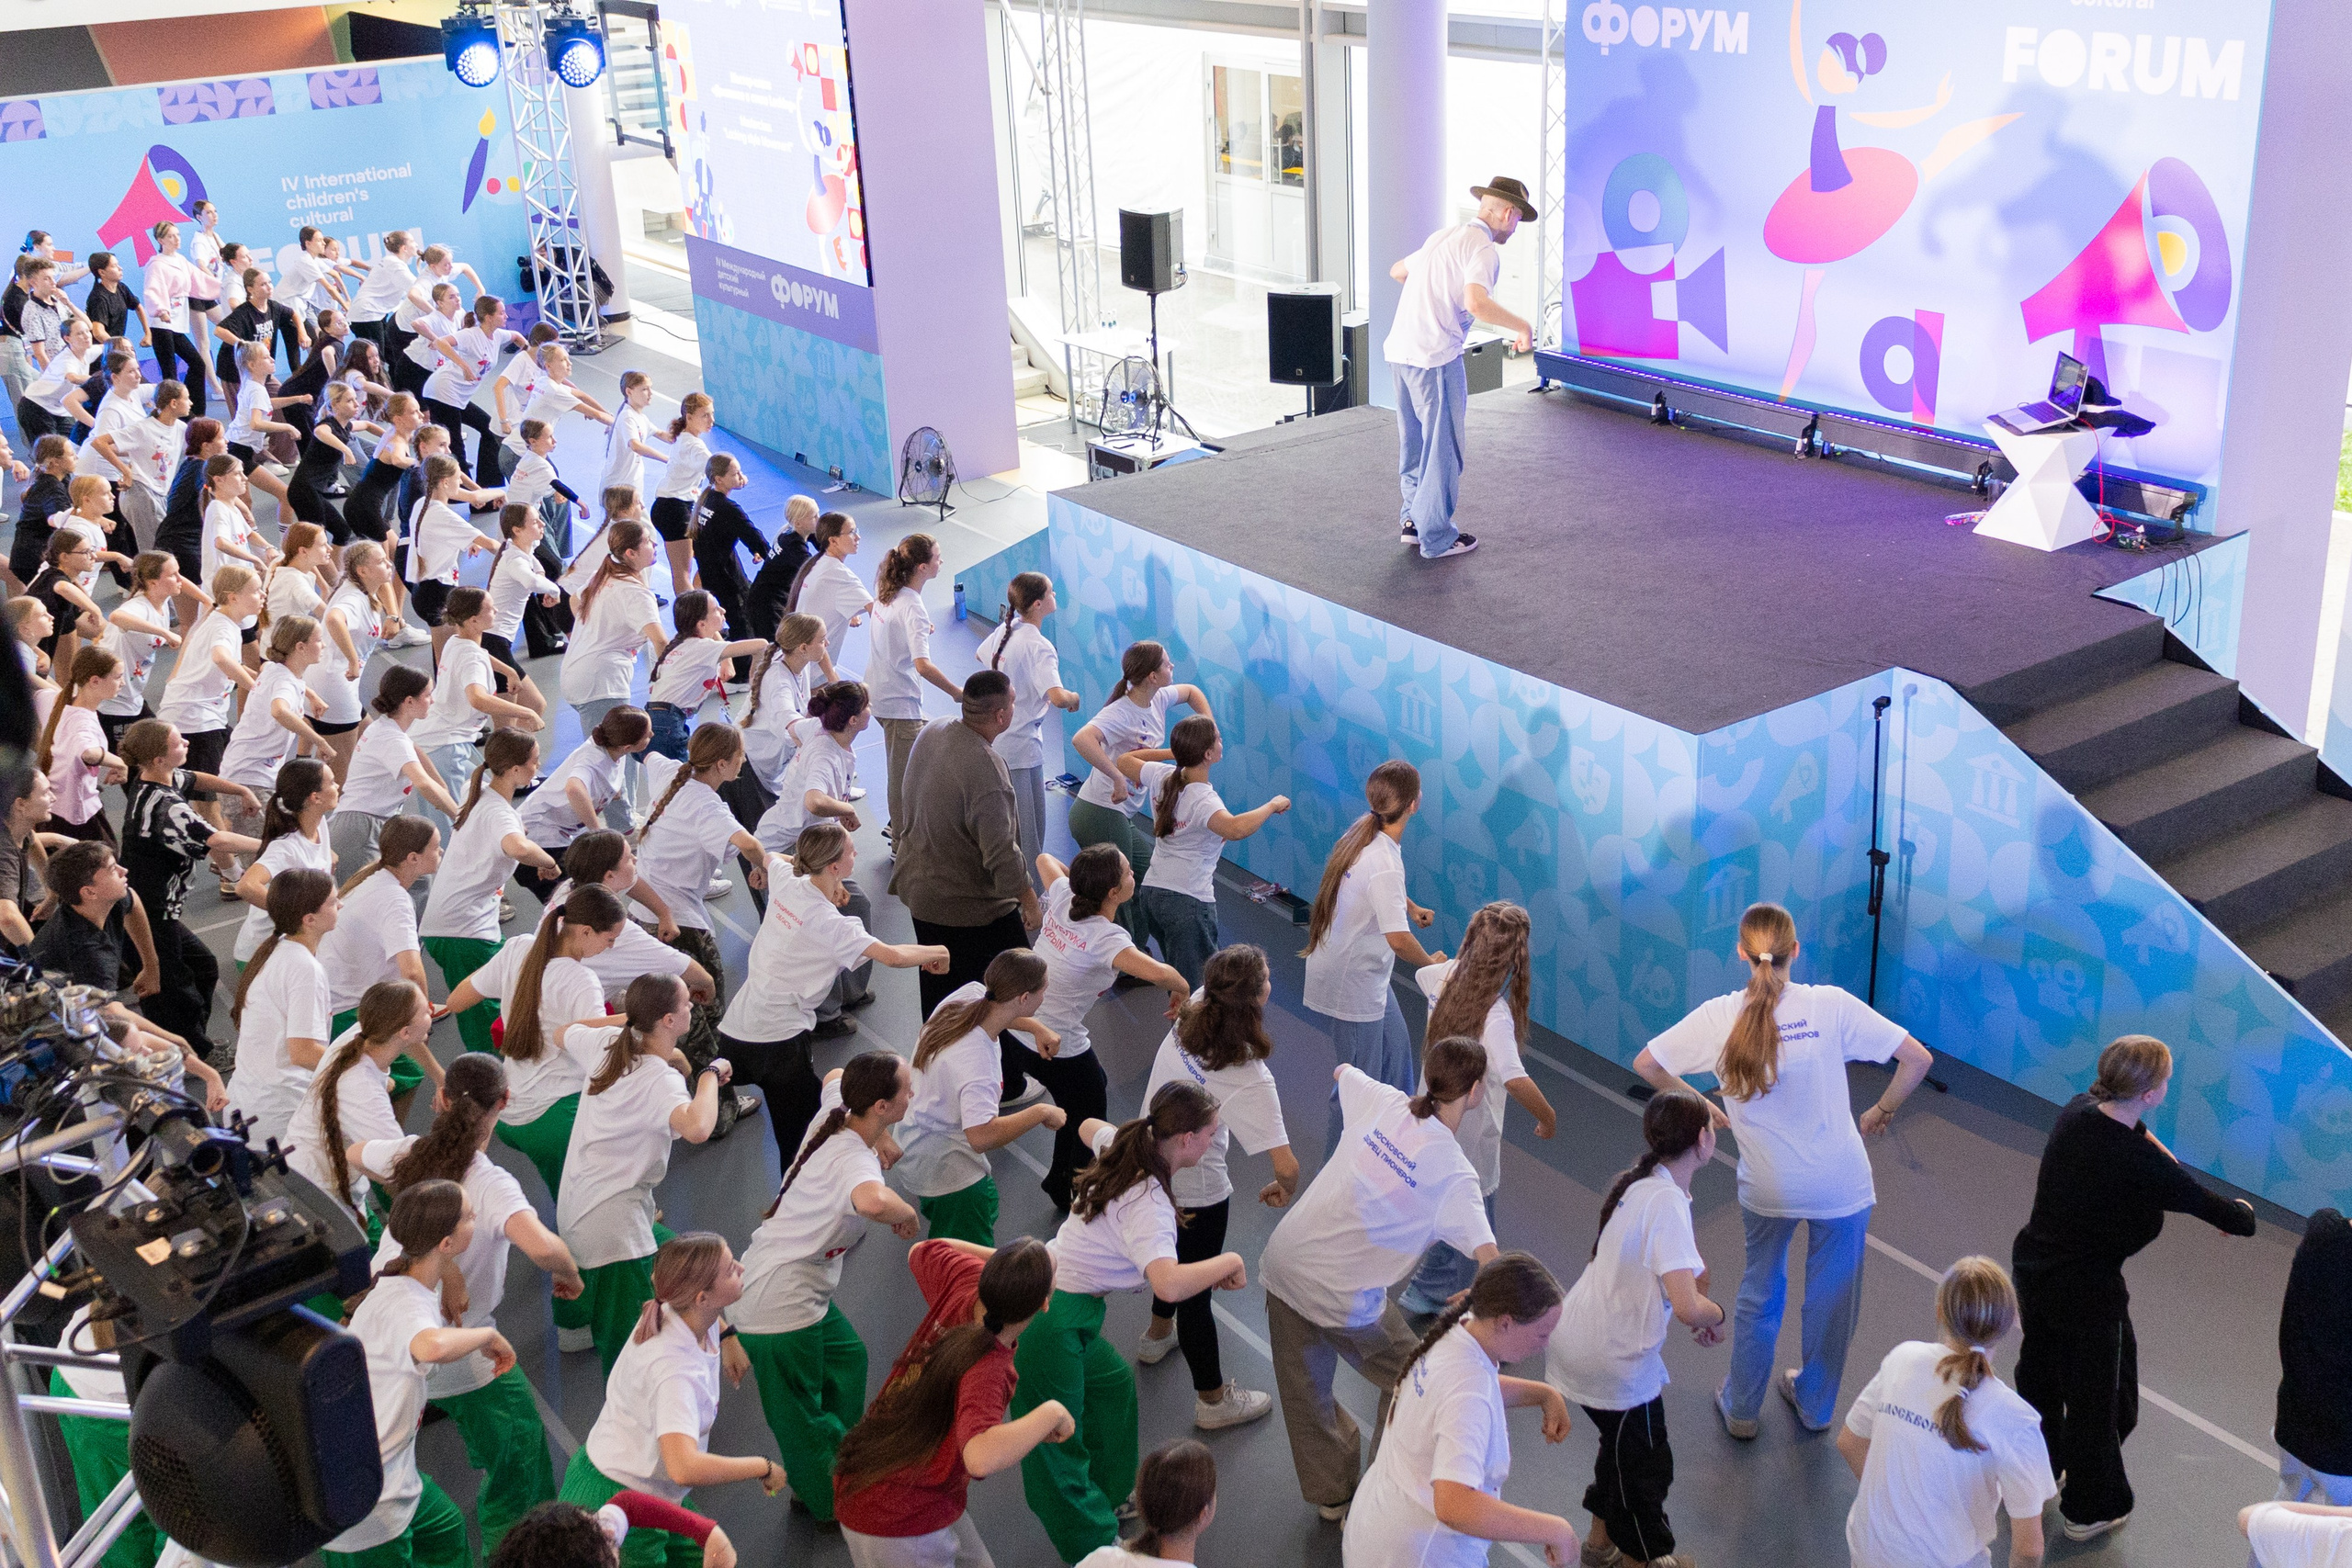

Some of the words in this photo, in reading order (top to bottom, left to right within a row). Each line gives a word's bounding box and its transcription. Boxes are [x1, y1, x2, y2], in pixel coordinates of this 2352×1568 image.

[1582, 0, 1749, 55] ФОРУМ
[2002, 26, 2245, 101] FORUM
[281, 175, 300, 192] IV
[304, 163, 413, 189] International
[286, 188, 369, 210] children's
[289, 206, 354, 229] cultural
[771, 273, 840, 321] ФОРУМ
[1043, 927, 1067, 953] КРЫМ
[1373, 1128, 1417, 1171] МОСКОВСКИЙ
[1380, 1152, 1418, 1189] ПИОНЕРОВ
